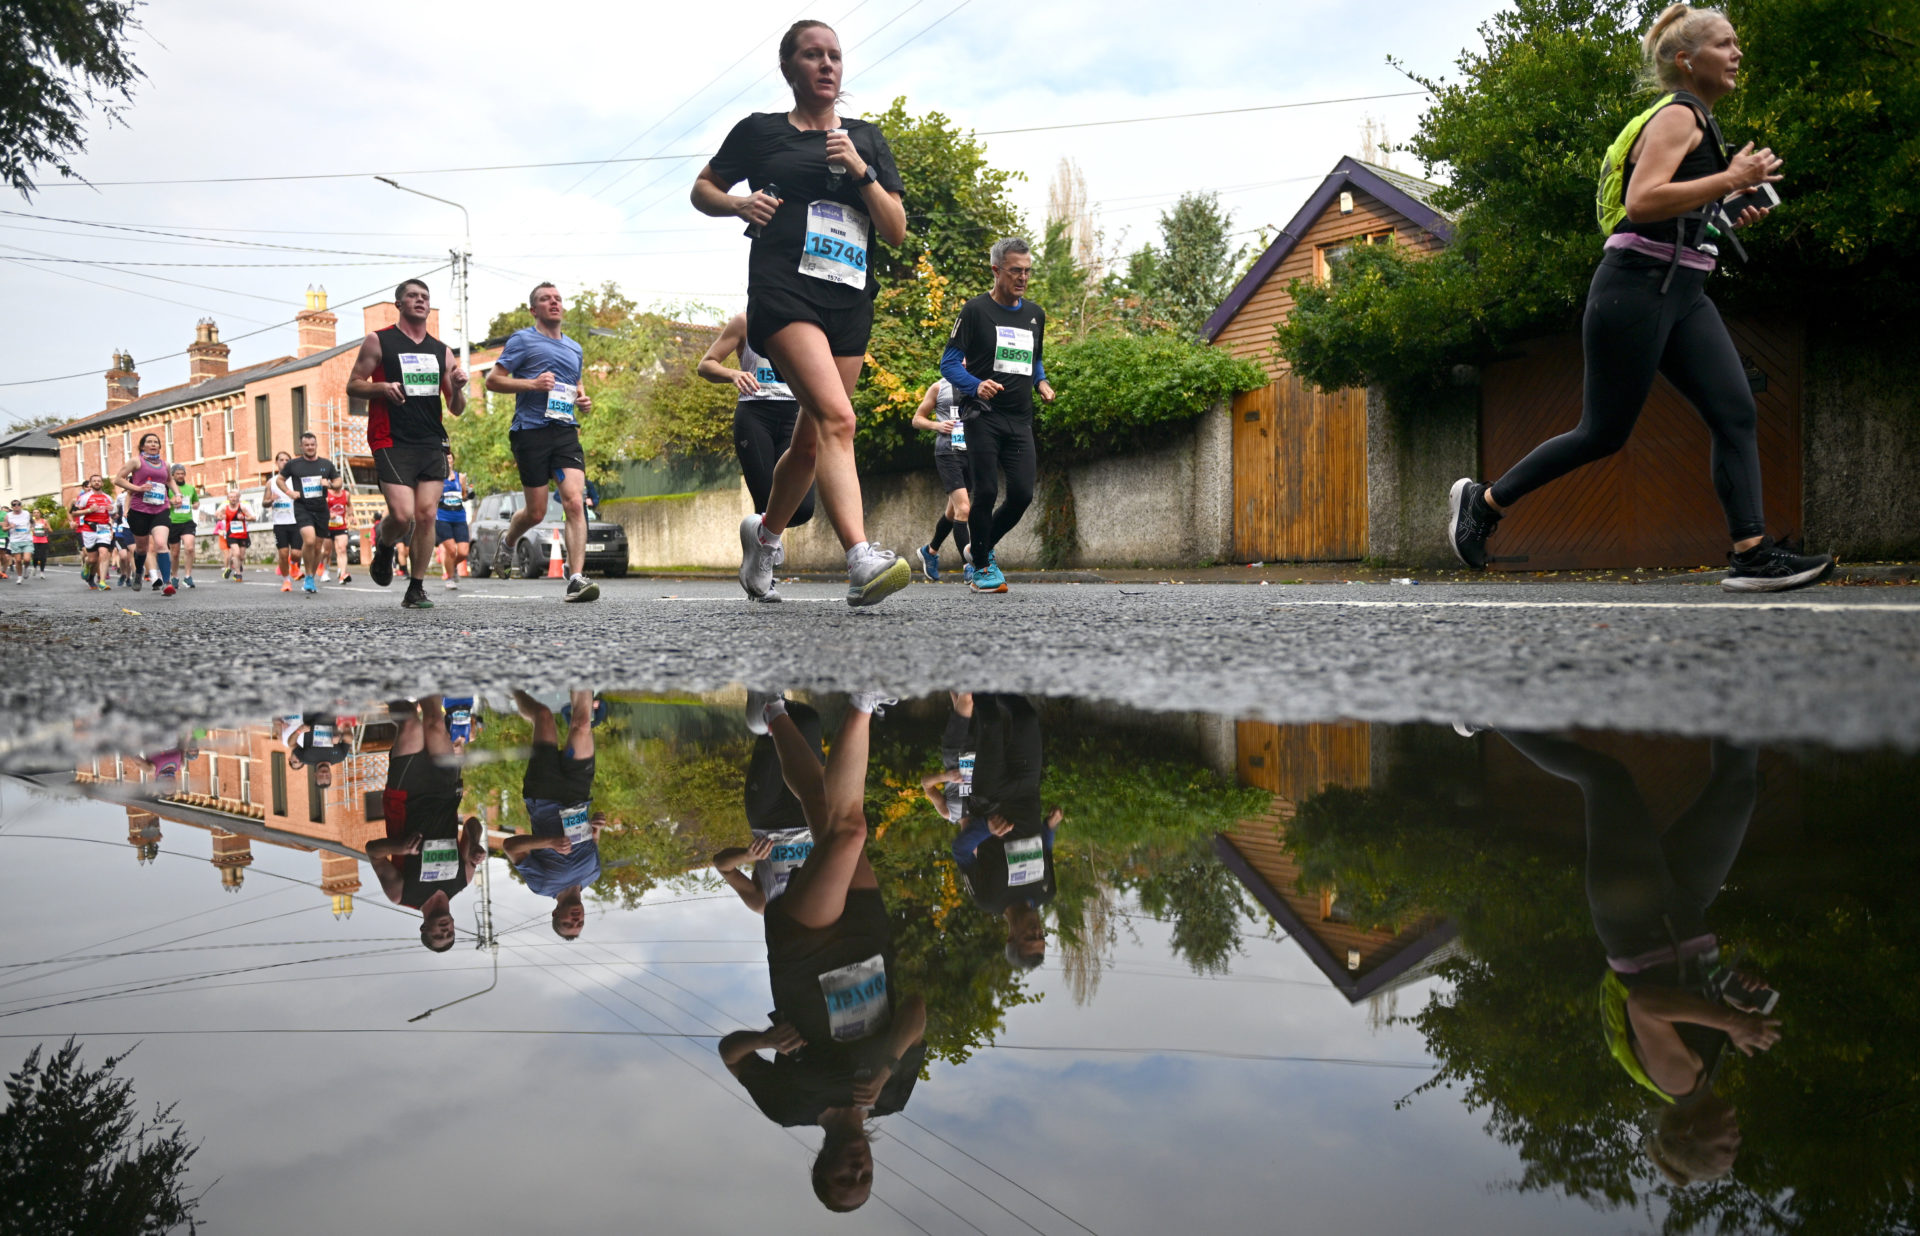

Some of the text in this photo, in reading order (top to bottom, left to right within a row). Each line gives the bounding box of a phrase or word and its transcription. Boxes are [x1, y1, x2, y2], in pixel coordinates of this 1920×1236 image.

[811, 236, 864, 267] 15746
[1001, 348, 1030, 362] 8569
[405, 374, 438, 384] 10445
